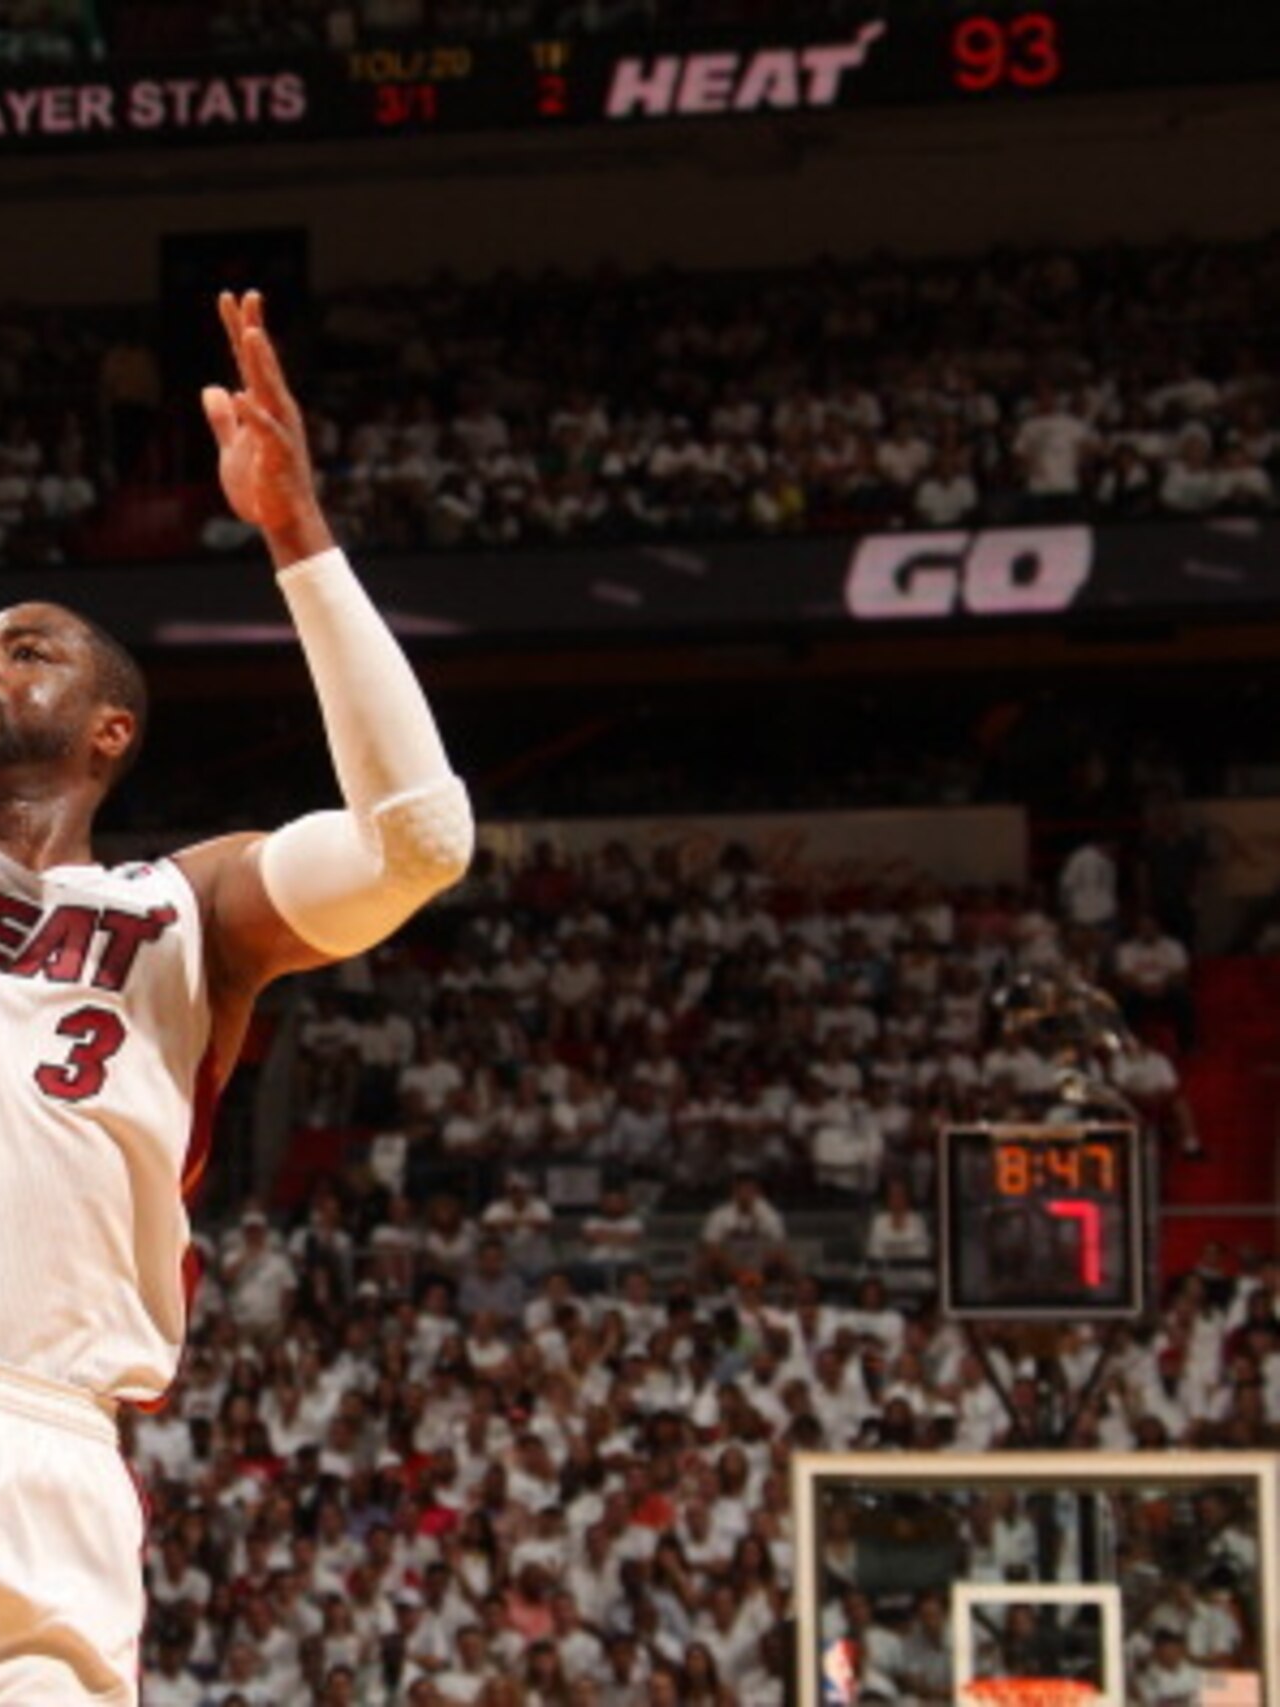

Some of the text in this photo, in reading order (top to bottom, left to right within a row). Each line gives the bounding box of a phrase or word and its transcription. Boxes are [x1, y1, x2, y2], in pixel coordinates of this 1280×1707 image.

[605, 19, 889, 118] HEAT
[951, 13, 1062, 90] 93
[128, 73, 308, 130] STATS
[537, 75, 566, 116] 2
[844, 524, 1093, 620] GO
[33, 1004, 126, 1102] 3
[994, 1144, 1116, 1196] 8:47
[1045, 1198, 1103, 1288] 7
